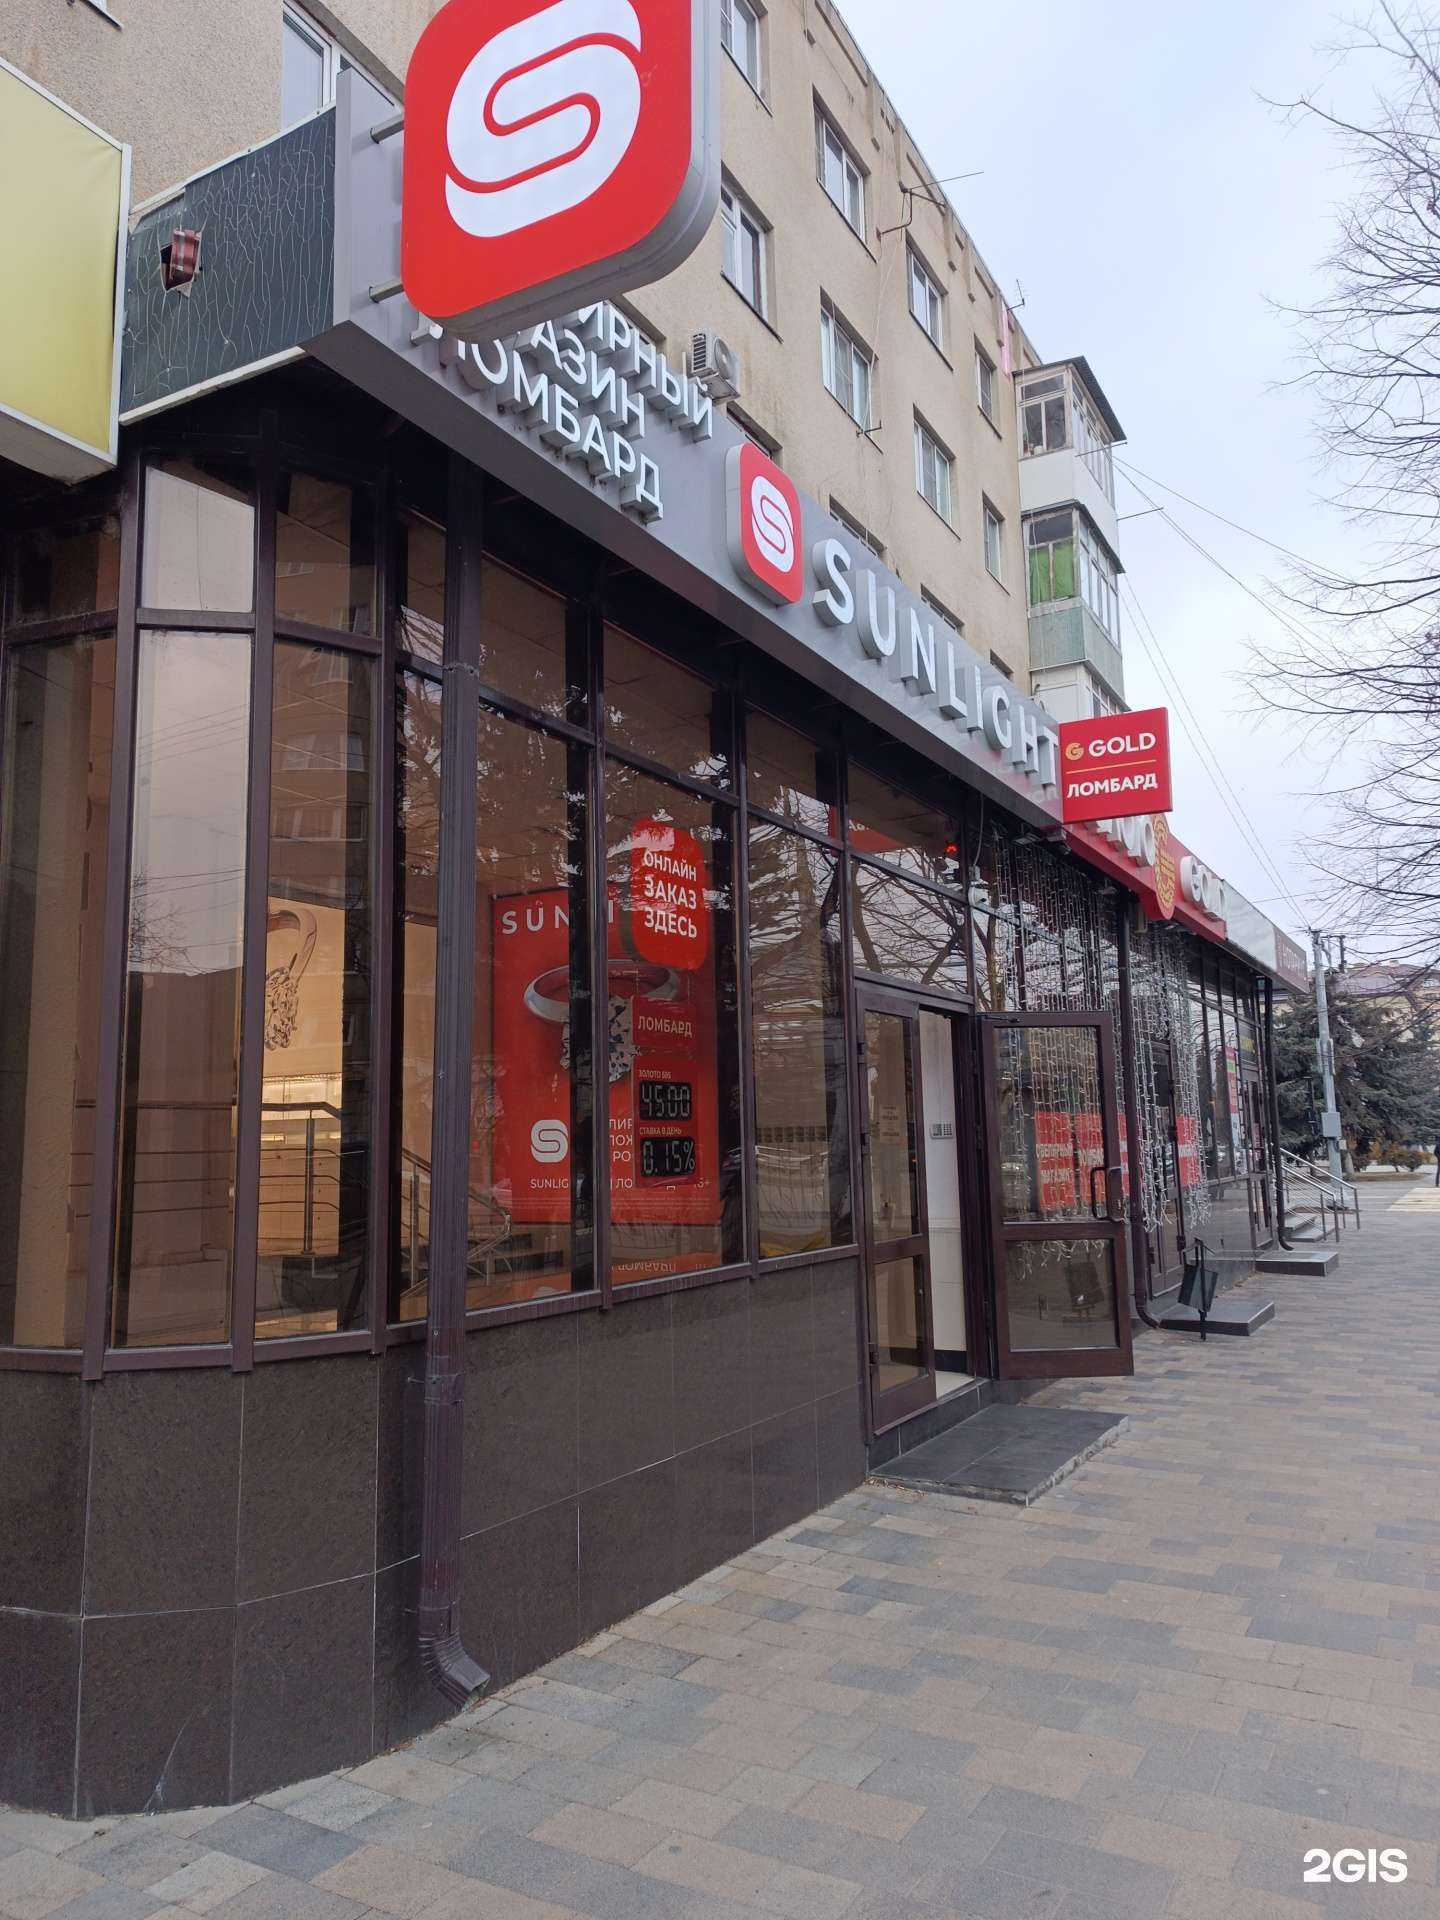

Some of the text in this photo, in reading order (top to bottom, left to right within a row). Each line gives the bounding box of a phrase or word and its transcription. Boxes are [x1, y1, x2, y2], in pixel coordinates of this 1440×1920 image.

[519, 320, 645, 439] АЗИН
[577, 300, 713, 439] ИРНЫЙ
[813, 538, 1059, 787] SUNLIGHT
[1088, 732, 1156, 758] GOLD
[1067, 773, 1158, 798] ЛОМБАРД
[644, 851, 697, 882] ОНЛАЙН
[645, 875, 697, 910] ЗАКАЗ
[645, 908, 698, 939] ЗДЕСЬ
[638, 1015, 692, 1038] ЛОМБАРД
[642, 1083, 690, 1117] 4500
[639, 1126, 661, 1136] СТАВКА
[667, 1127, 682, 1137] ДЕНЬ
[643, 1140, 695, 1174] 0.15%
[530, 1178, 569, 1190] SUNLIG
